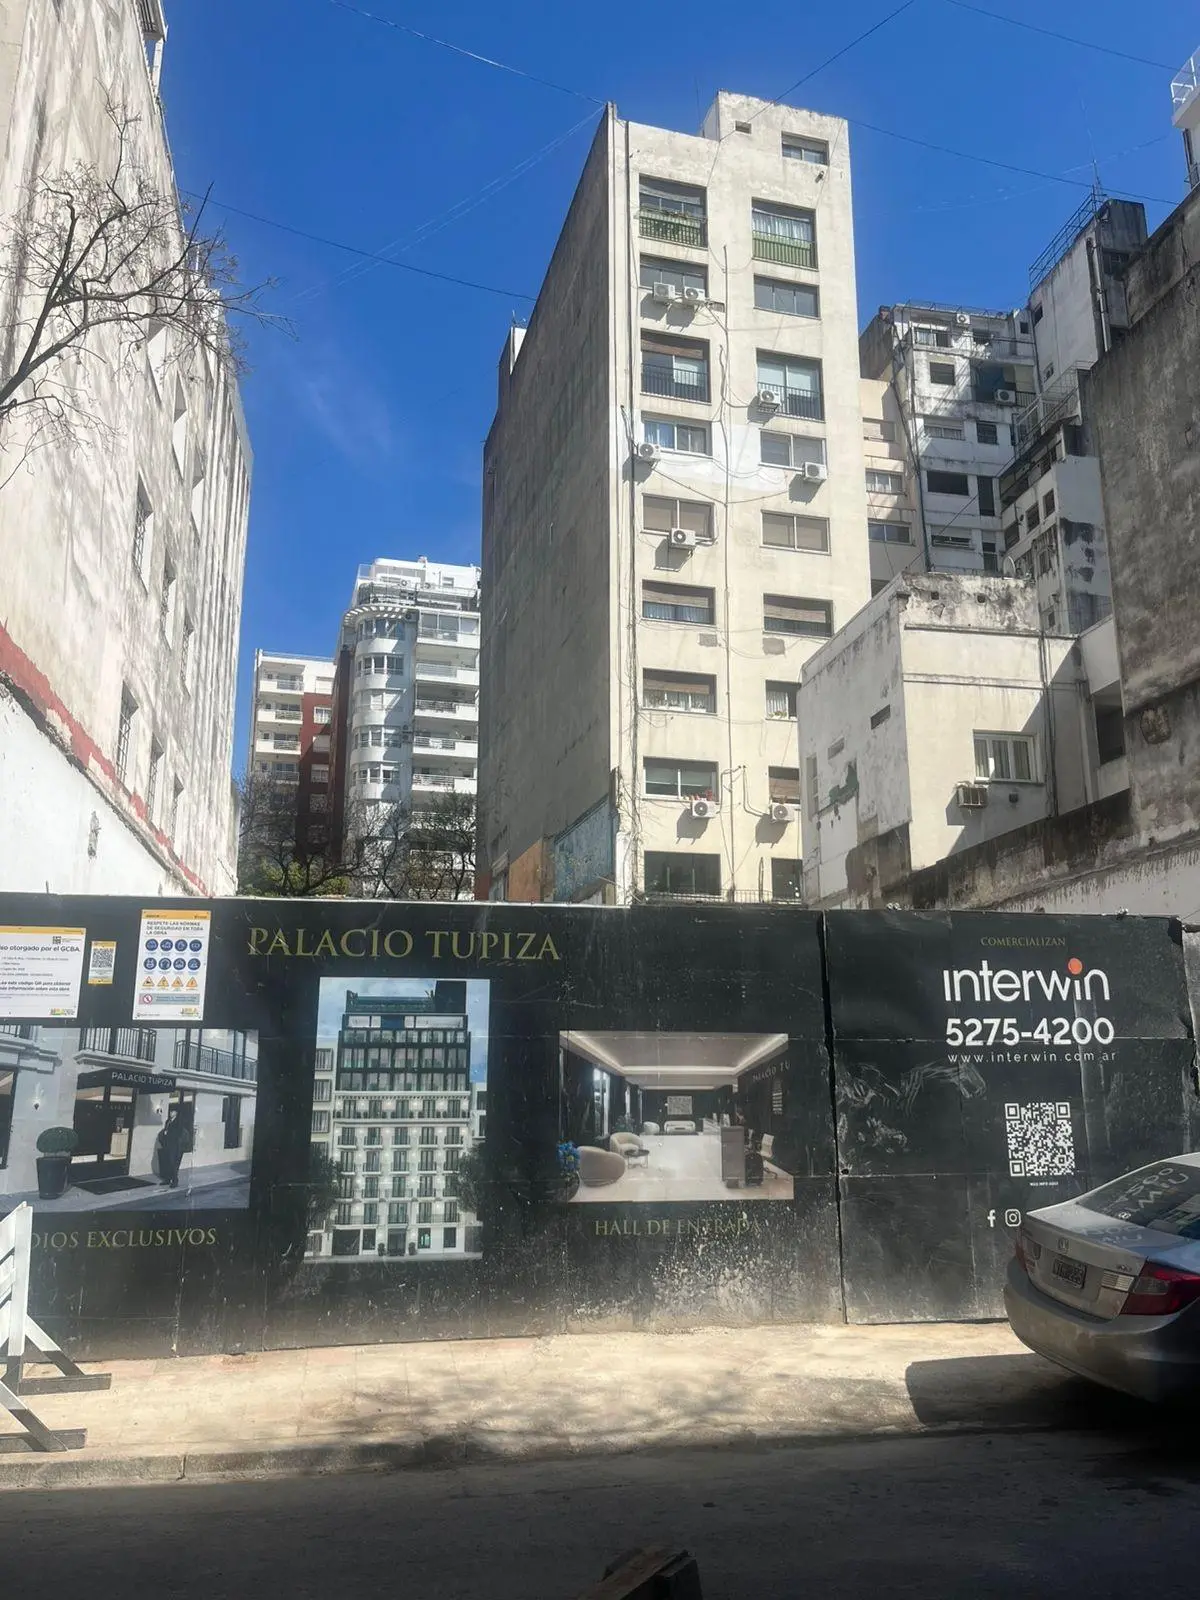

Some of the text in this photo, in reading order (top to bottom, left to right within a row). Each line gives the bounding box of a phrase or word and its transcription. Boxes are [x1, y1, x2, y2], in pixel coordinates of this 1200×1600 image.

[248, 927, 562, 961] PALACIO TUPIZA
[980, 936, 1066, 947] COMERCIALIZAN
[943, 957, 1111, 1002] interwin
[945, 1017, 1116, 1047] 5275-4200
[947, 1050, 1117, 1064] www.interwin.comar
[111, 1071, 174, 1087] PALACIO TUPIZA
[595, 1217, 763, 1236] HALL DE ENTRADA
[86, 1227, 217, 1248] EXCLUSIVOS
